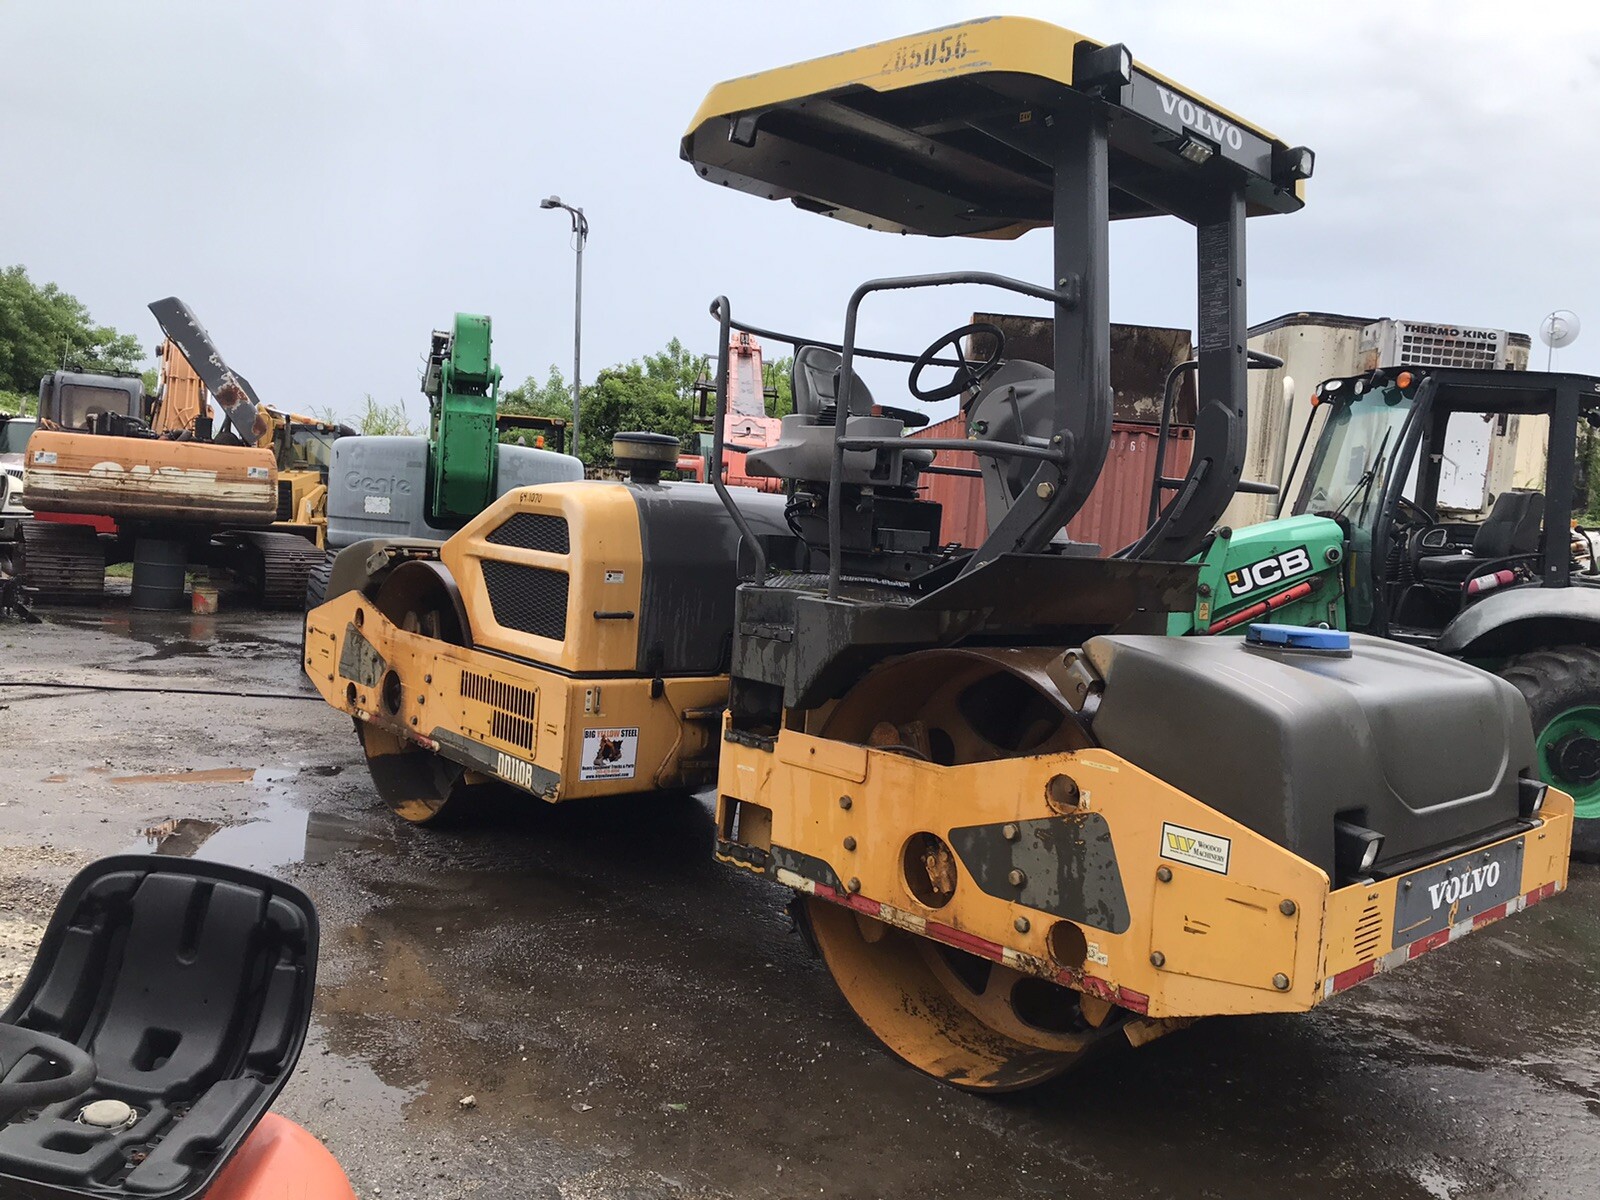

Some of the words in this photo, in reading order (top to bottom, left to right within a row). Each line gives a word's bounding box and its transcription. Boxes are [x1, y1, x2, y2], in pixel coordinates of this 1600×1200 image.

[1156, 85, 1242, 150] VOLVO
[1404, 324, 1459, 336] THERMO
[1462, 330, 1497, 340] KING
[345, 471, 411, 495] Genie
[1230, 548, 1310, 595] JCB
[585, 730, 596, 738] BIG
[498, 752, 533, 789] DD110B
[1428, 861, 1500, 911] VOLVO
